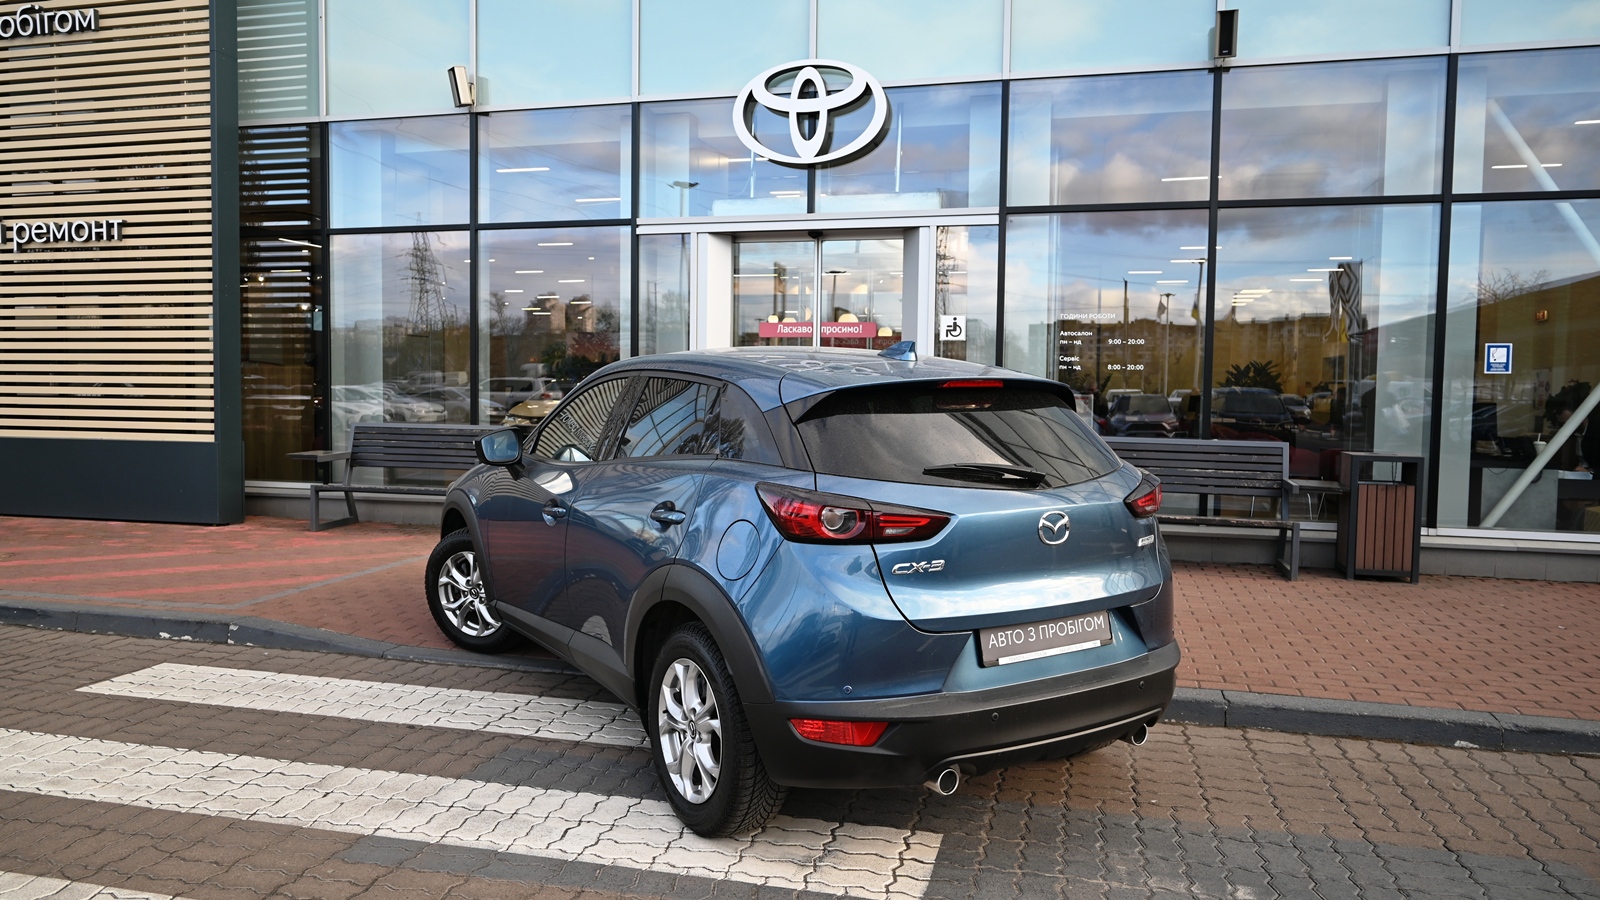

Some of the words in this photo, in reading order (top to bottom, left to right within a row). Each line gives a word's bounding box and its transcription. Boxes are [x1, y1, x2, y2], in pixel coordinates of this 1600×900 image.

[0, 4, 95, 38] обігом
[13, 219, 123, 253] ремонт
[777, 324, 813, 334] Ласкаво
[821, 324, 863, 336] просимо!
[891, 559, 946, 575] CX-3
[988, 629, 1025, 649] АВТО
[1038, 615, 1105, 640] ПРОБІГОМ
